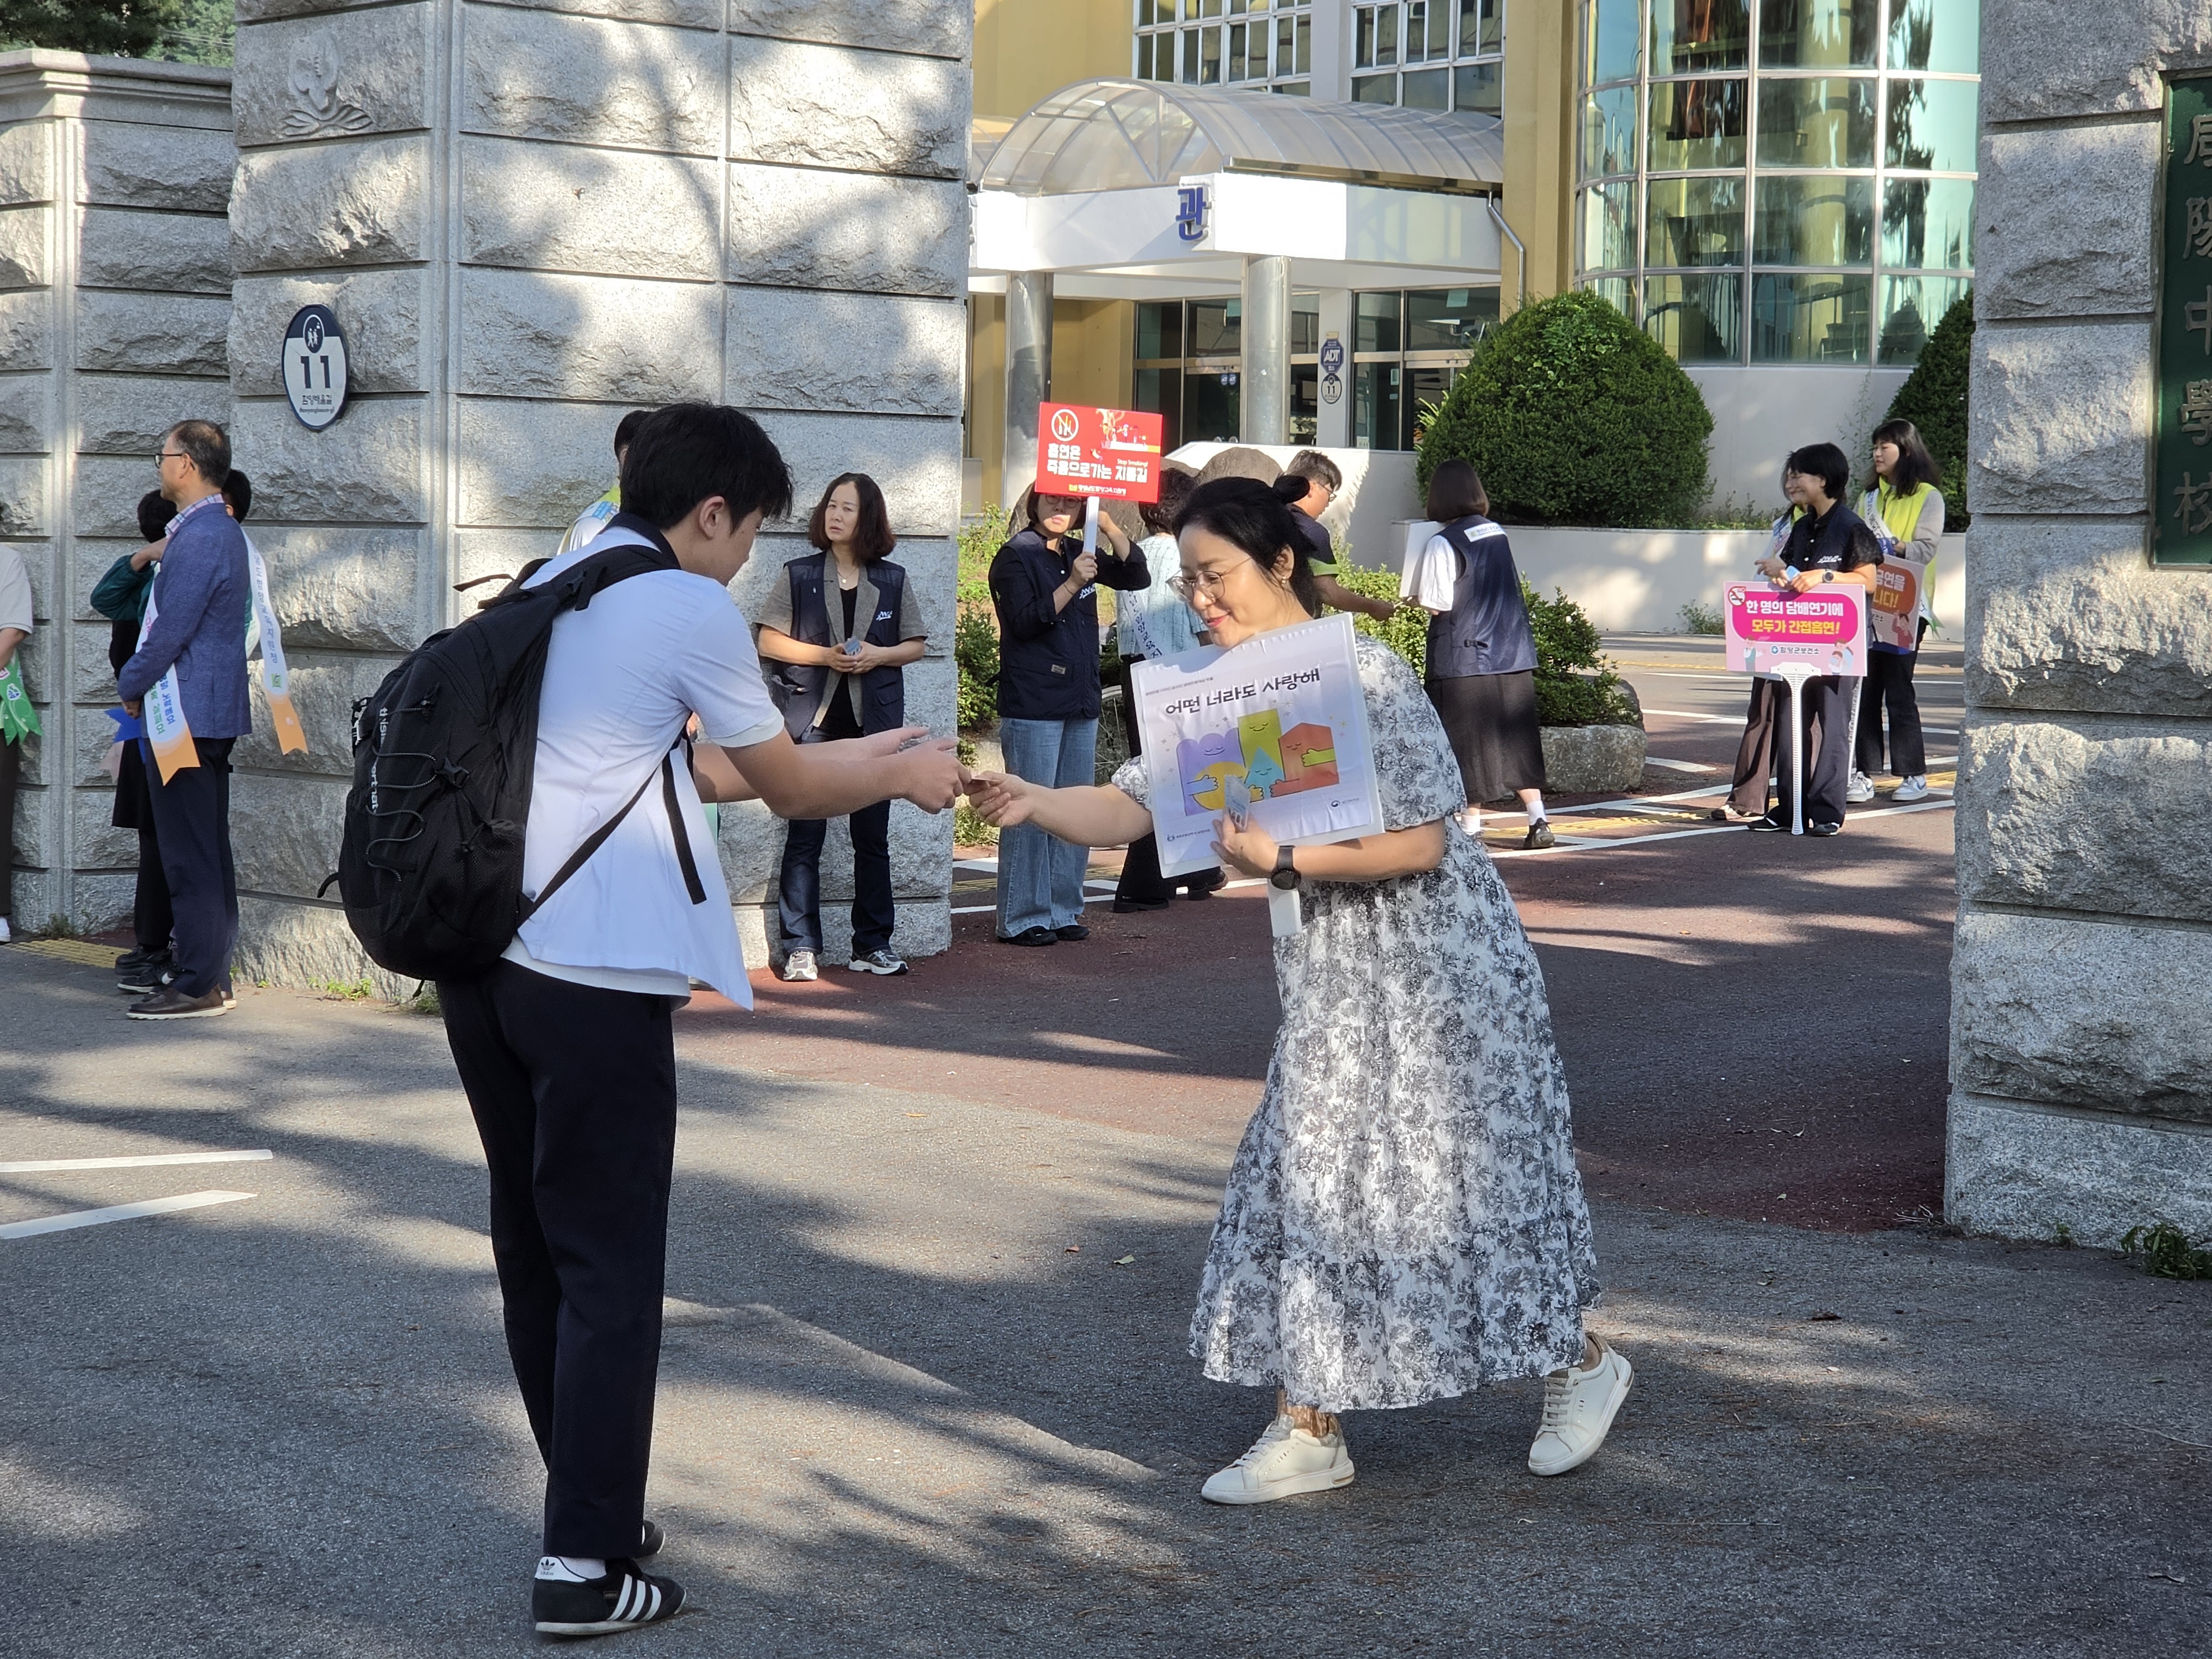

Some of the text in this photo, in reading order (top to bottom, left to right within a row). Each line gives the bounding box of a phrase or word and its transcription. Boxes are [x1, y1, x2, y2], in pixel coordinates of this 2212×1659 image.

[1176, 187, 1207, 241] 관
[1324, 349, 1340, 362] ADT
[300, 355, 331, 389] 11
[1327, 386, 1335, 394] 11
[1048, 443, 1081, 460] 흡연은
[1128, 460, 1148, 468] Smoking!
[1115, 466, 1148, 483] 지름길
[1746, 601, 1844, 617] 한 명의 담배연기에
[1752, 619, 1840, 634] 모두가 간접흡연!
[1165, 696, 1200, 715] 어떤
[1206, 684, 1257, 707] 너라도
[1262, 668, 1321, 692] 사랑해
